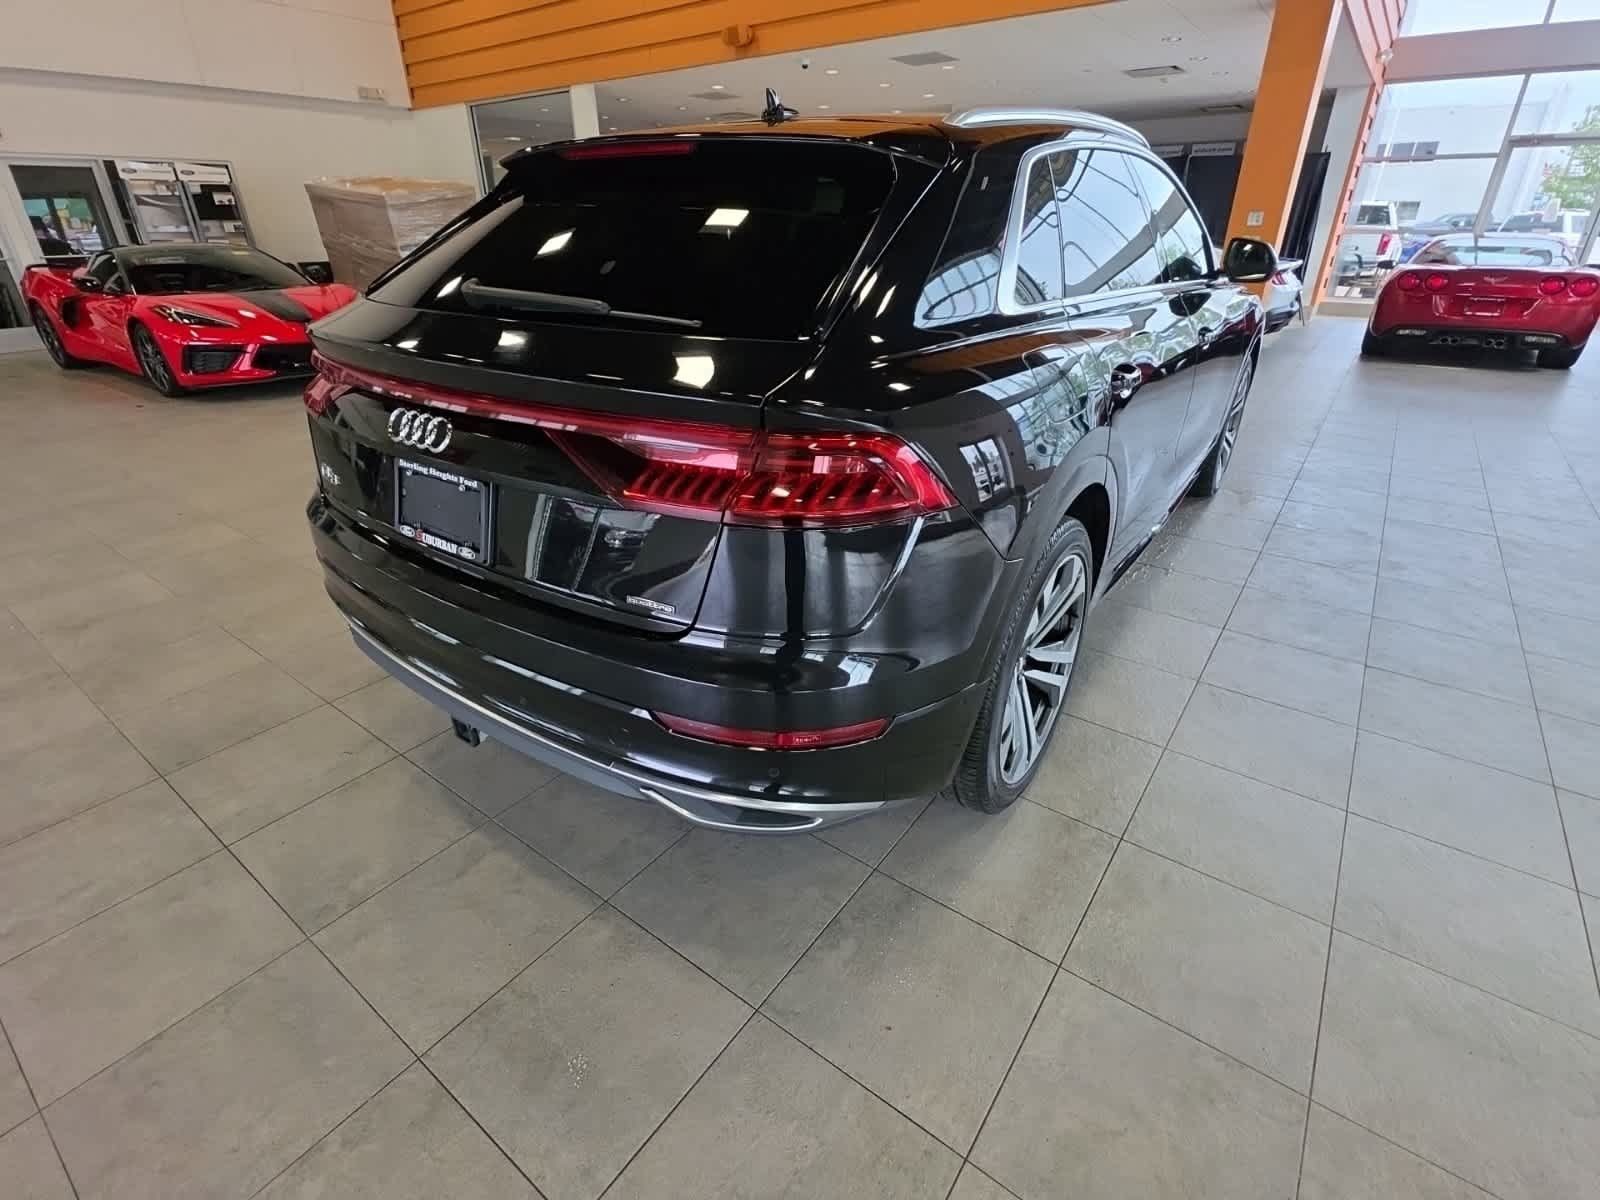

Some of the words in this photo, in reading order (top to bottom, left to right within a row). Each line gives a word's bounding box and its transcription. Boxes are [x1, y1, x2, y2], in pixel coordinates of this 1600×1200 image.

[399, 459, 429, 475] Sterling
[429, 467, 458, 482] Heights
[459, 476, 478, 488] Ford
[416, 528, 459, 554] SUBURBAN
